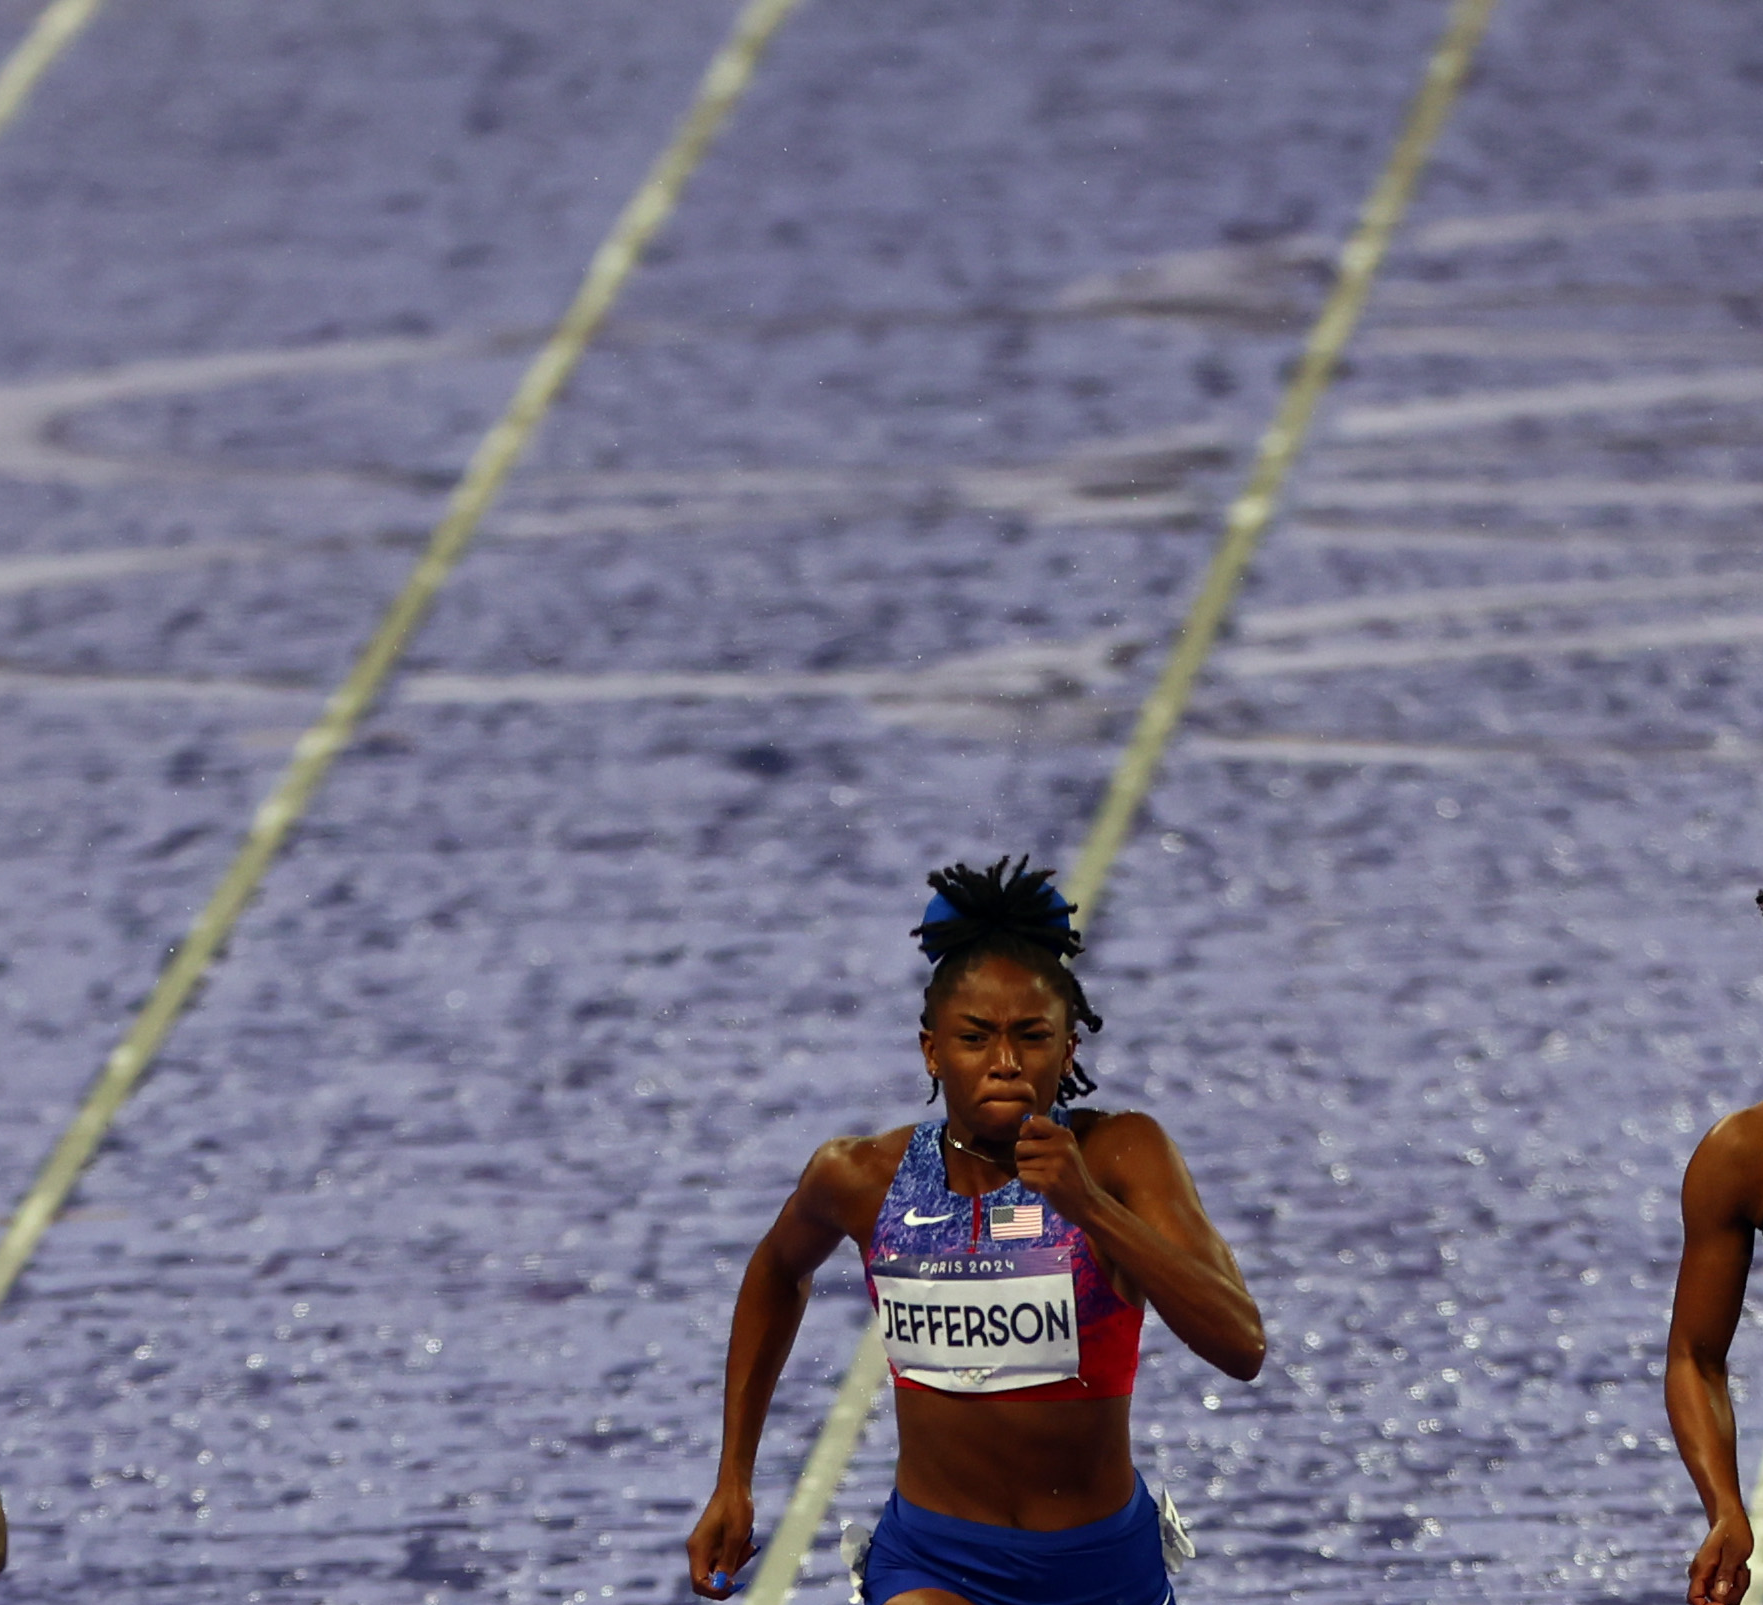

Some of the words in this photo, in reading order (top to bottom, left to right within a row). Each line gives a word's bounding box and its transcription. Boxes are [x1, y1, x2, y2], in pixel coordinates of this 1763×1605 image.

[919, 1261, 963, 1275] PARIS
[969, 1259, 1014, 1274] 2024
[883, 1298, 1070, 1347] JEFFERSON
